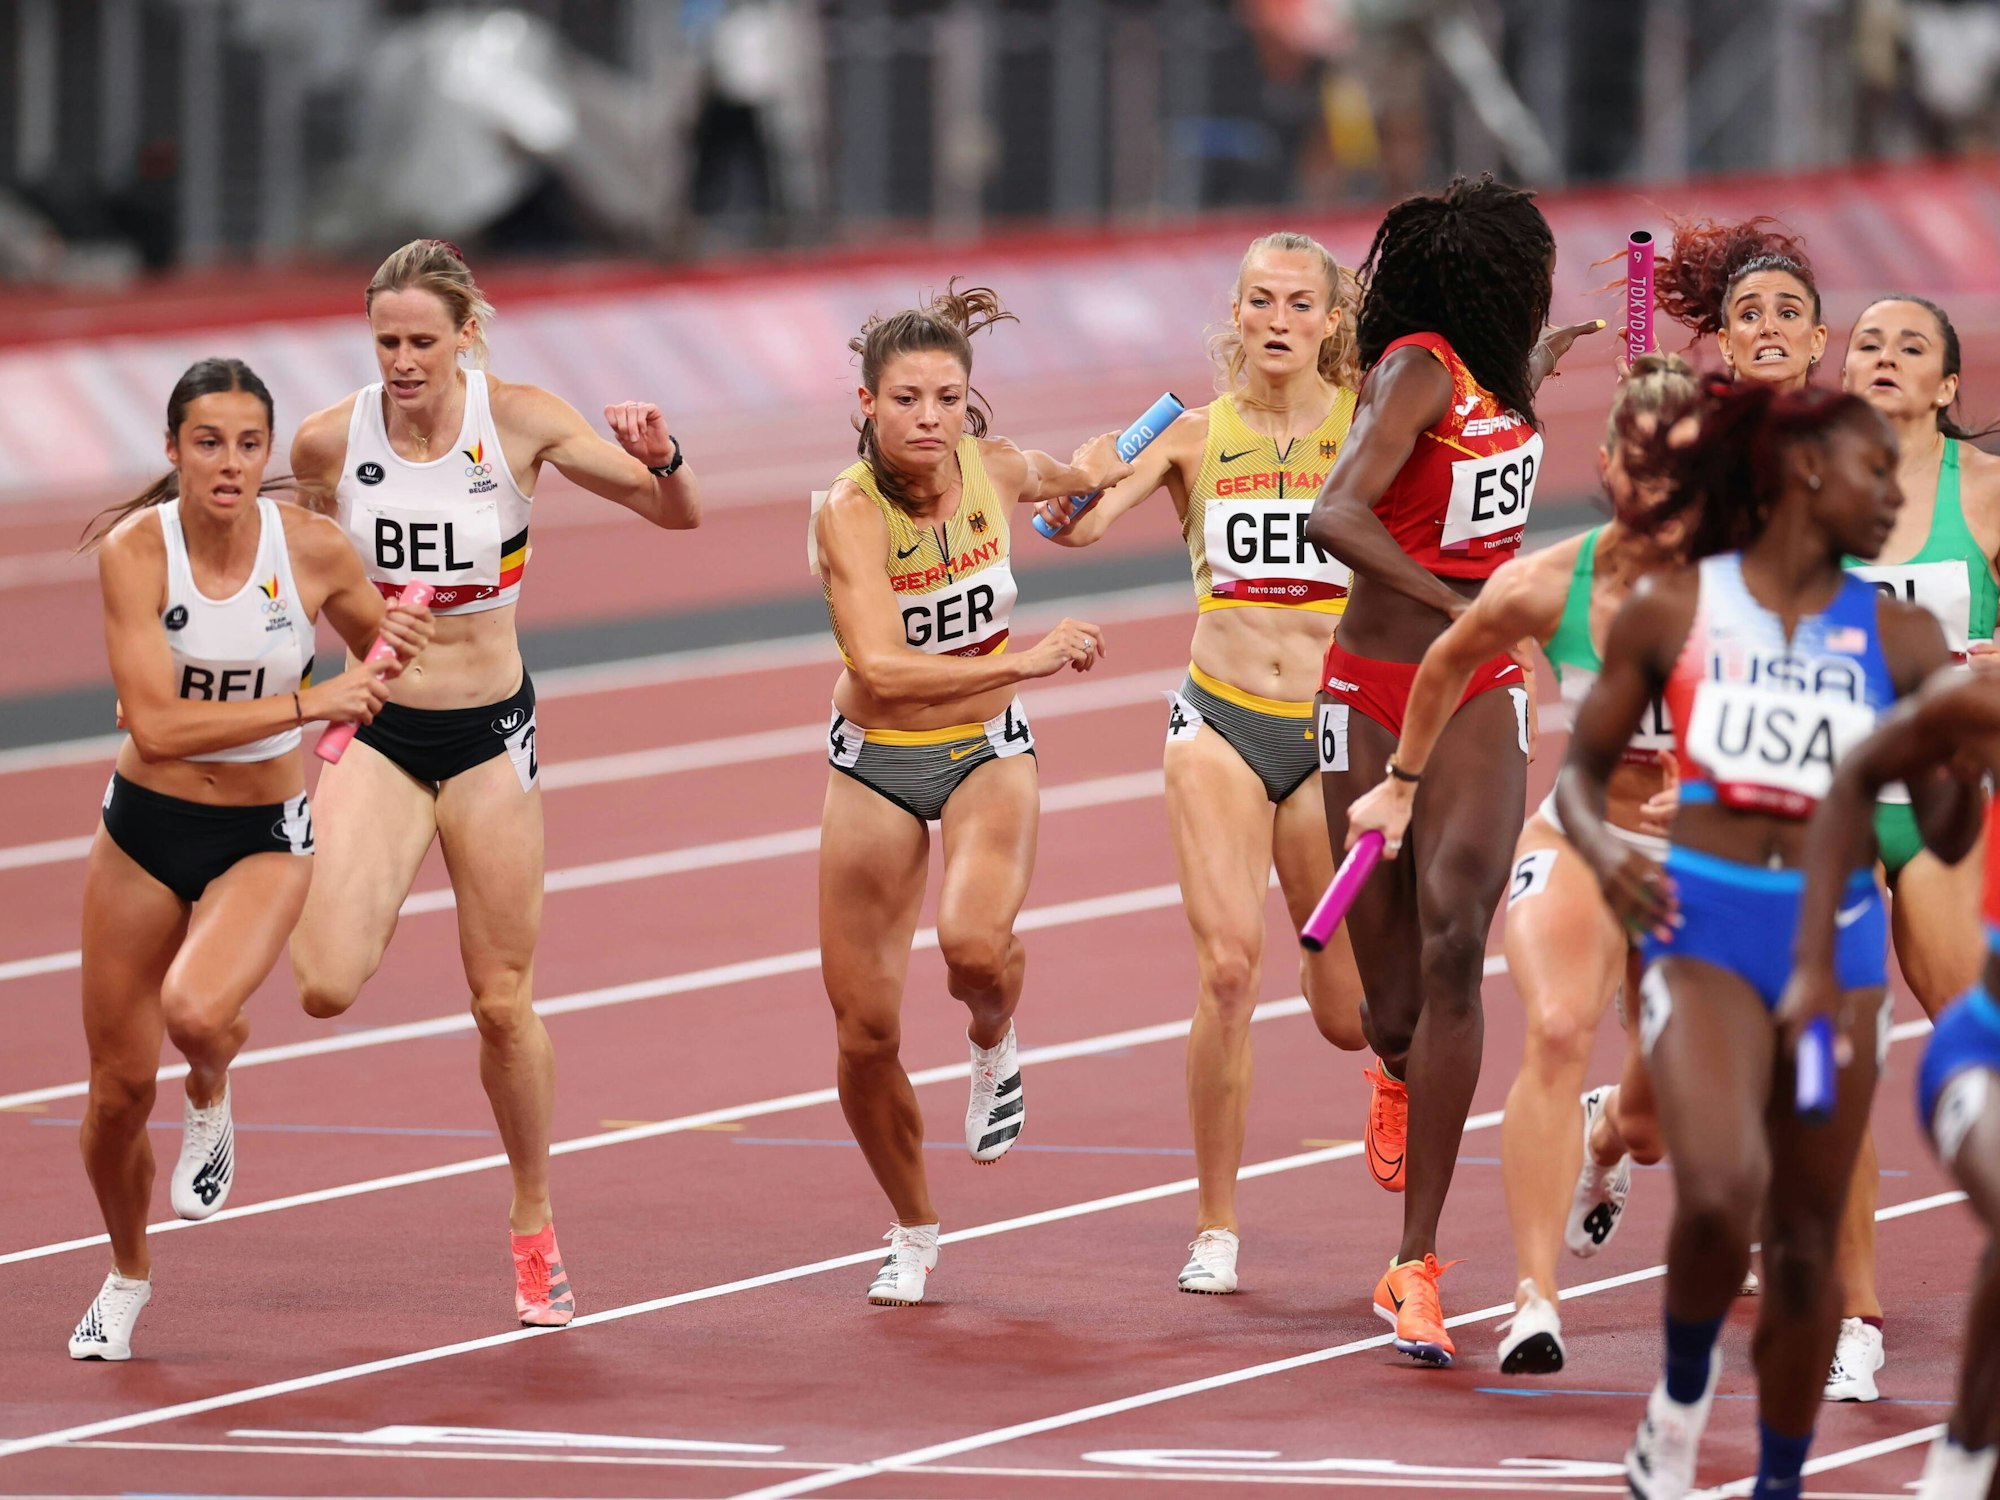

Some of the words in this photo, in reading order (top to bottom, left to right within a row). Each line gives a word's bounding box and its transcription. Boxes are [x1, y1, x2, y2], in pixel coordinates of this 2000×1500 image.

[1630, 277, 1647, 331] TOKYO
[1629, 333, 1646, 371] 20
[469, 483, 498, 494] BELGIUM
[473, 479, 492, 488] TEAM
[1216, 471, 1329, 497] GERMAN
[1471, 454, 1535, 523] ESP
[375, 518, 474, 572] BEL
[1226, 512, 1328, 564] GER
[889, 537, 999, 592] GERMANY
[1247, 586, 1269, 595] TOKYO
[1269, 586, 1287, 595] 2020
[902, 584, 995, 647] GER
[1328, 676, 1361, 693] ESP
[830, 714, 848, 758] 4
[1003, 703, 1030, 744] 4
[1322, 711, 1336, 764] 6
[1715, 702, 1835, 770] USA
[1511, 855, 1537, 901] 5
